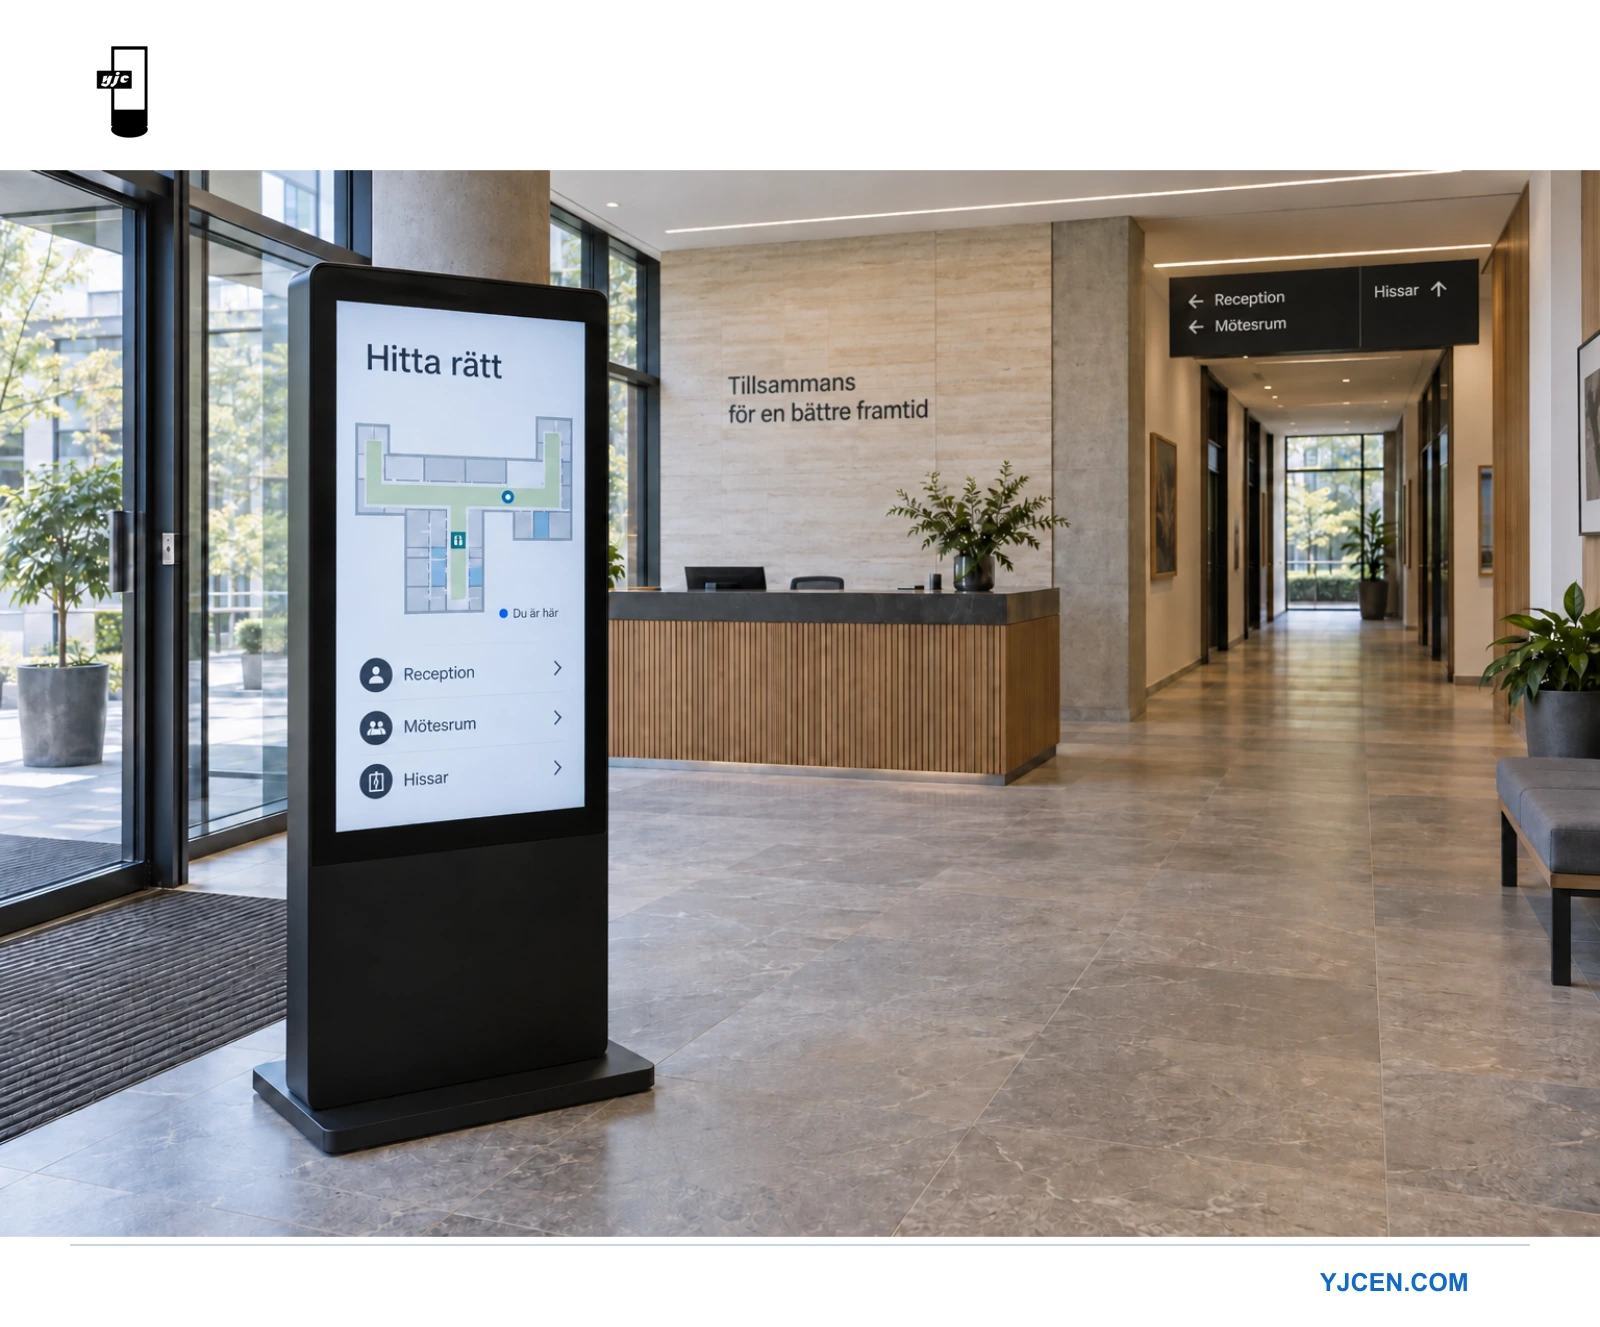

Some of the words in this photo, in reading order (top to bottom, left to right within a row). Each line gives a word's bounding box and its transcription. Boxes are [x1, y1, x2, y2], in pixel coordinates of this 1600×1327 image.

[1214, 290, 1286, 308] Reception
[1374, 284, 1419, 298] Hissar
[1214, 318, 1287, 333] Mötesrum
[367, 343, 441, 375] Hitta
[451, 351, 503, 379] rätt
[728, 375, 856, 395] Tillsammans
[728, 404, 756, 424] för
[761, 408, 785, 423] en
[791, 402, 851, 422] bättre
[857, 399, 929, 420] framtid
[513, 608, 527, 619] Du
[529, 607, 540, 618] är
[542, 607, 559, 618] här
[404, 665, 475, 683] Reception
[404, 718, 477, 734] Mötesrum
[404, 771, 449, 787] Hissar
